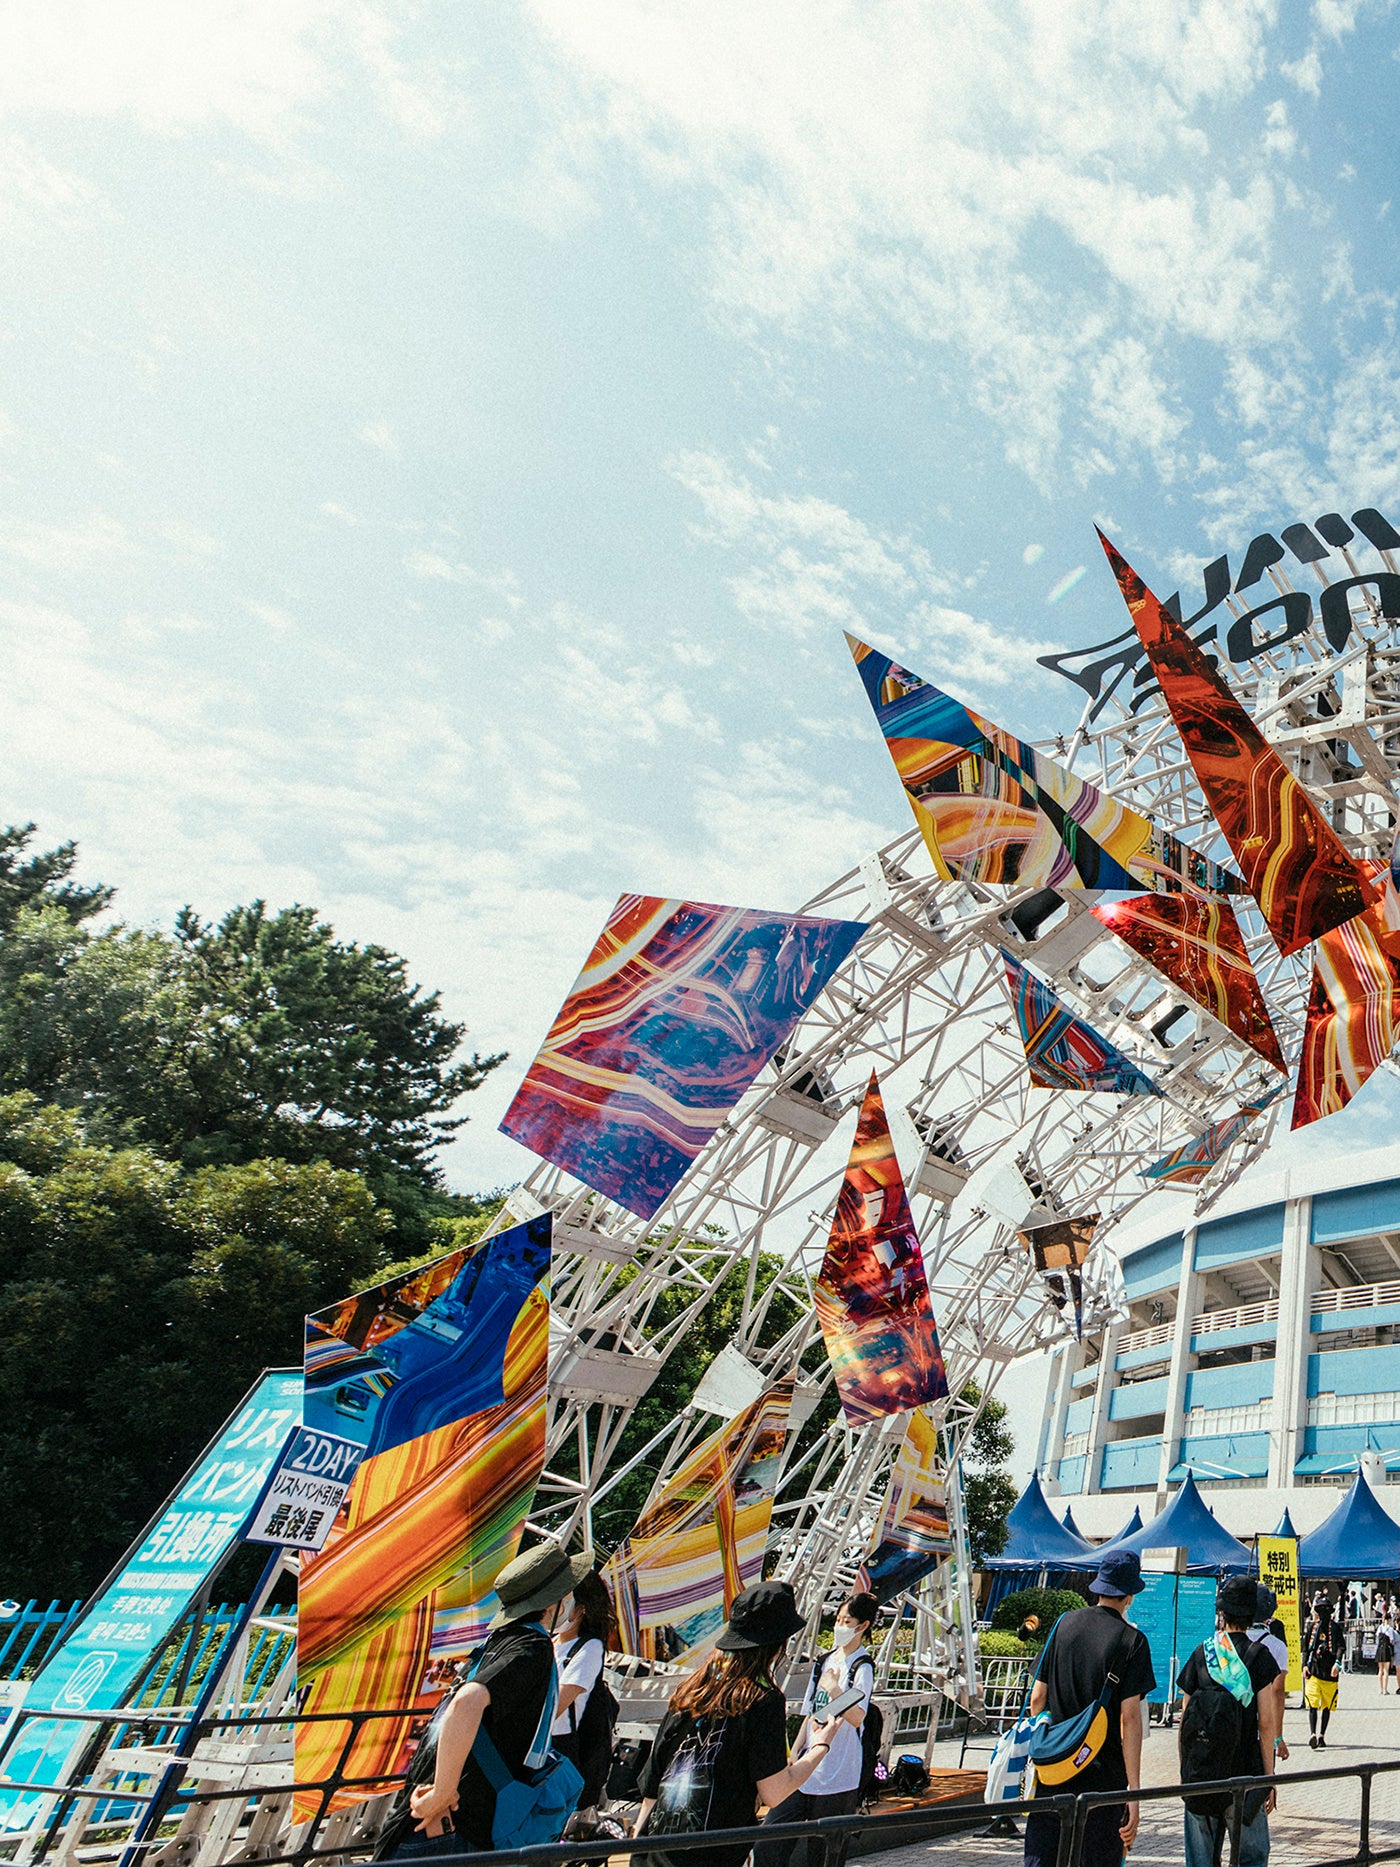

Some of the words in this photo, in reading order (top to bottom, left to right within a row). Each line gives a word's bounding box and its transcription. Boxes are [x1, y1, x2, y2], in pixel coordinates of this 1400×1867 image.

[291, 1435, 359, 1479] 2DAY
[273, 1475, 344, 1508] リストバンド引換
[138, 1511, 245, 1563] 引換所
[264, 1503, 325, 1542] 最後尾
[1267, 1551, 1290, 1572] 特別
